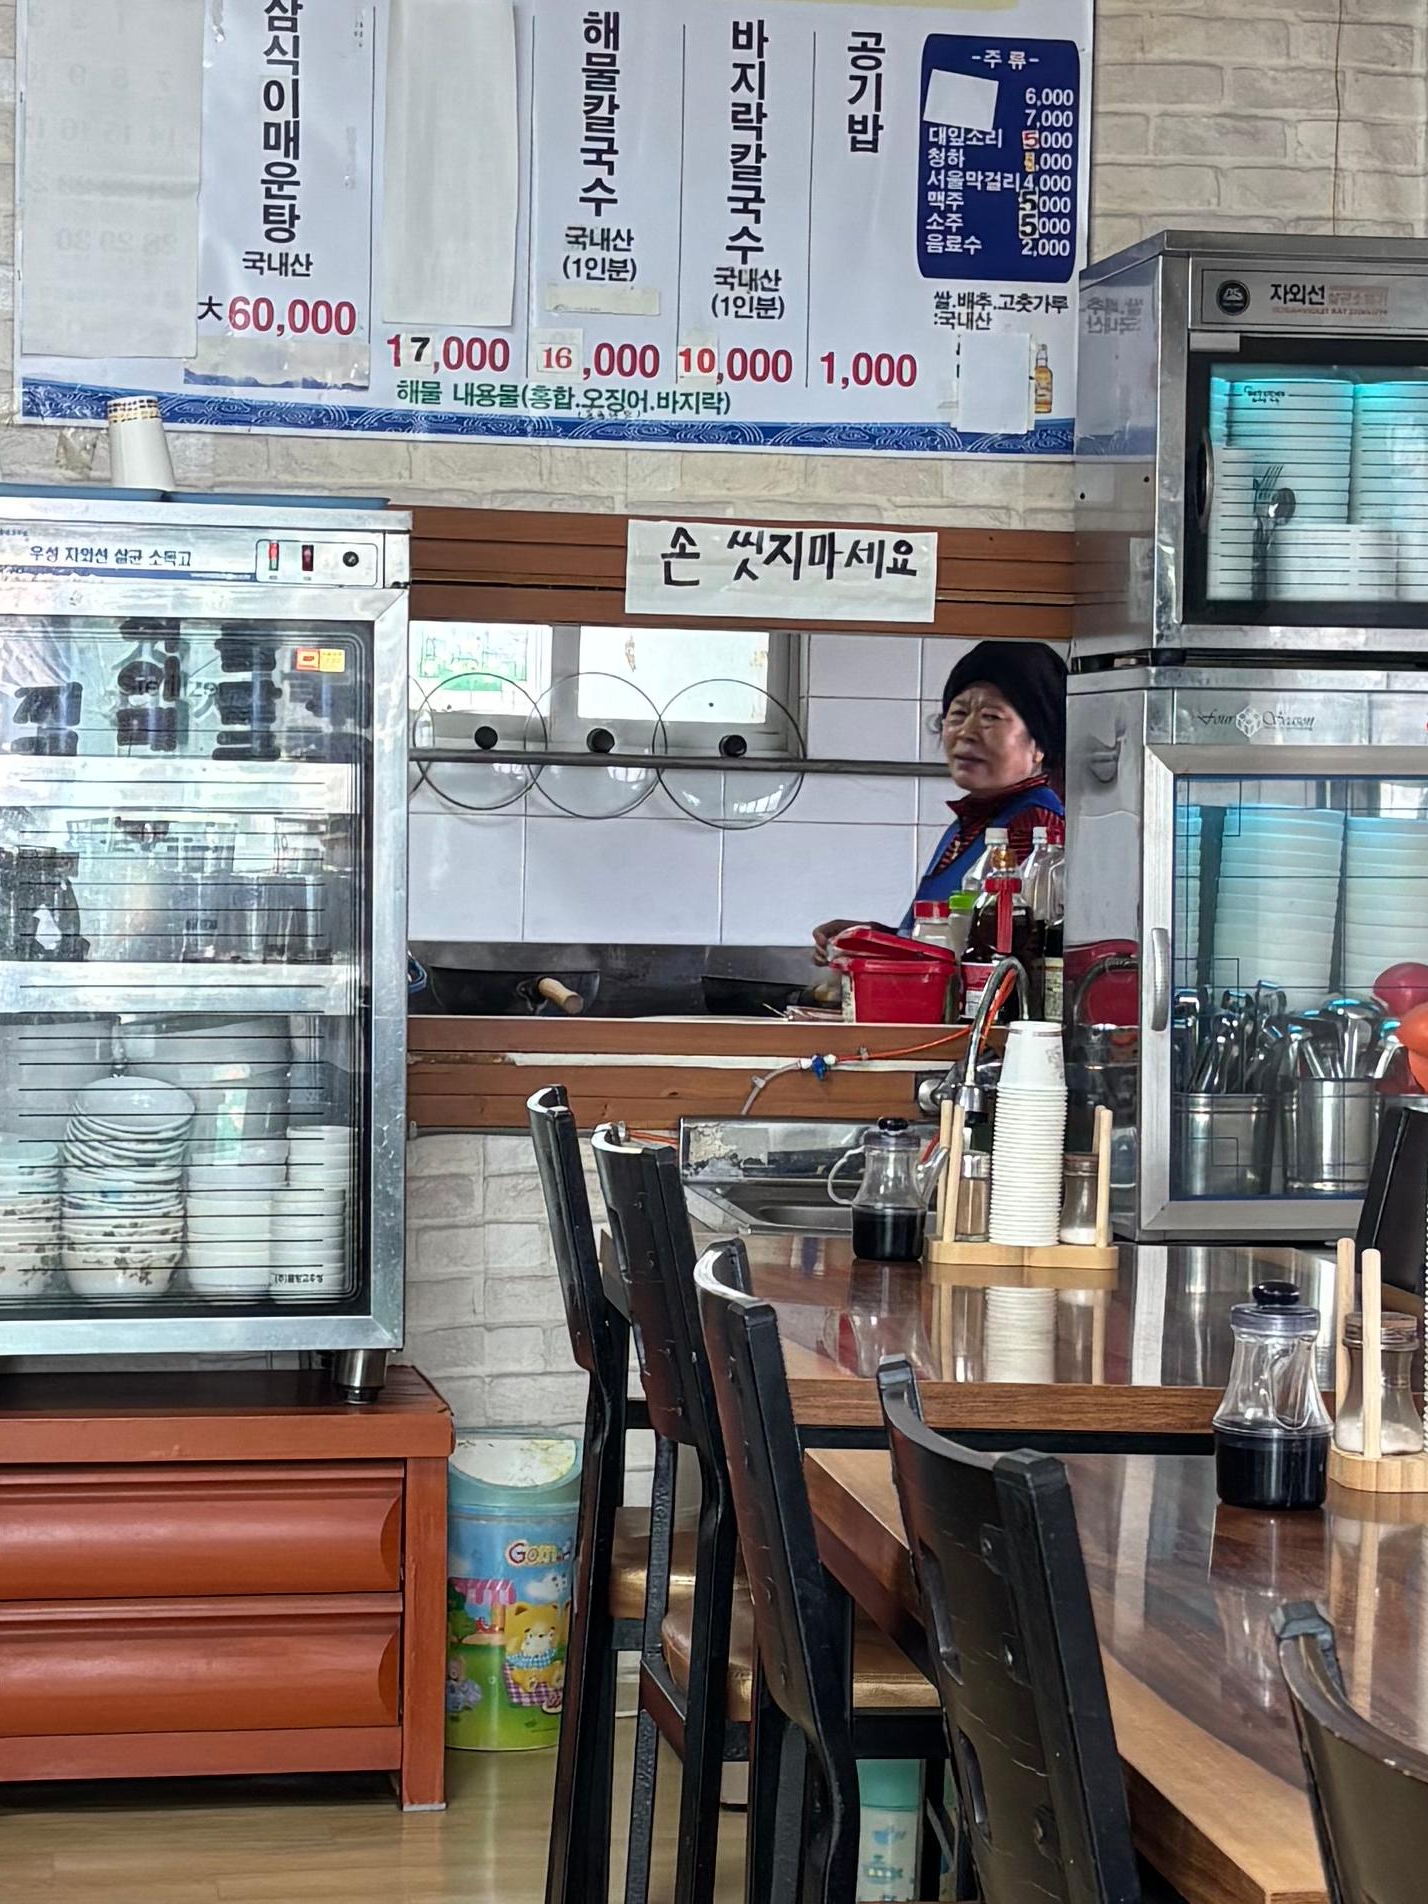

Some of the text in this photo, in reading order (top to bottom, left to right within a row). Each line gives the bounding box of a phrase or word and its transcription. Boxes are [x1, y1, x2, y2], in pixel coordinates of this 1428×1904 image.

[847, 31, 886, 154] 공기밥
[1025, 88, 1074, 107] 6,000
[579, 11, 621, 217] 해물칼국수
[1024, 109, 1073, 128] 7,000
[725, 19, 769, 265] 바지락칼국수
[928, 148, 965, 168] 청하
[927, 170, 1020, 192] 서울막걸리
[927, 191, 965, 211] 맥주
[926, 213, 964, 233] 소주
[566, 227, 635, 253] 국내산
[926, 234, 1070, 257] 음료수 2,000
[242, 251, 314, 277] 국내산
[562, 256, 638, 284] (1인분)
[713, 267, 782, 293] 국내산
[711, 293, 786, 321] (1인분)
[1270, 283, 1325, 306] 자외선
[387, 334, 511, 374] 17,000
[542, 343, 661, 381] 16,000
[679, 348, 793, 385] 10,000
[820, 351, 918, 389] 1,000
[396, 380, 443, 406] 해물
[661, 526, 918, 586] 손 씻지마세요
